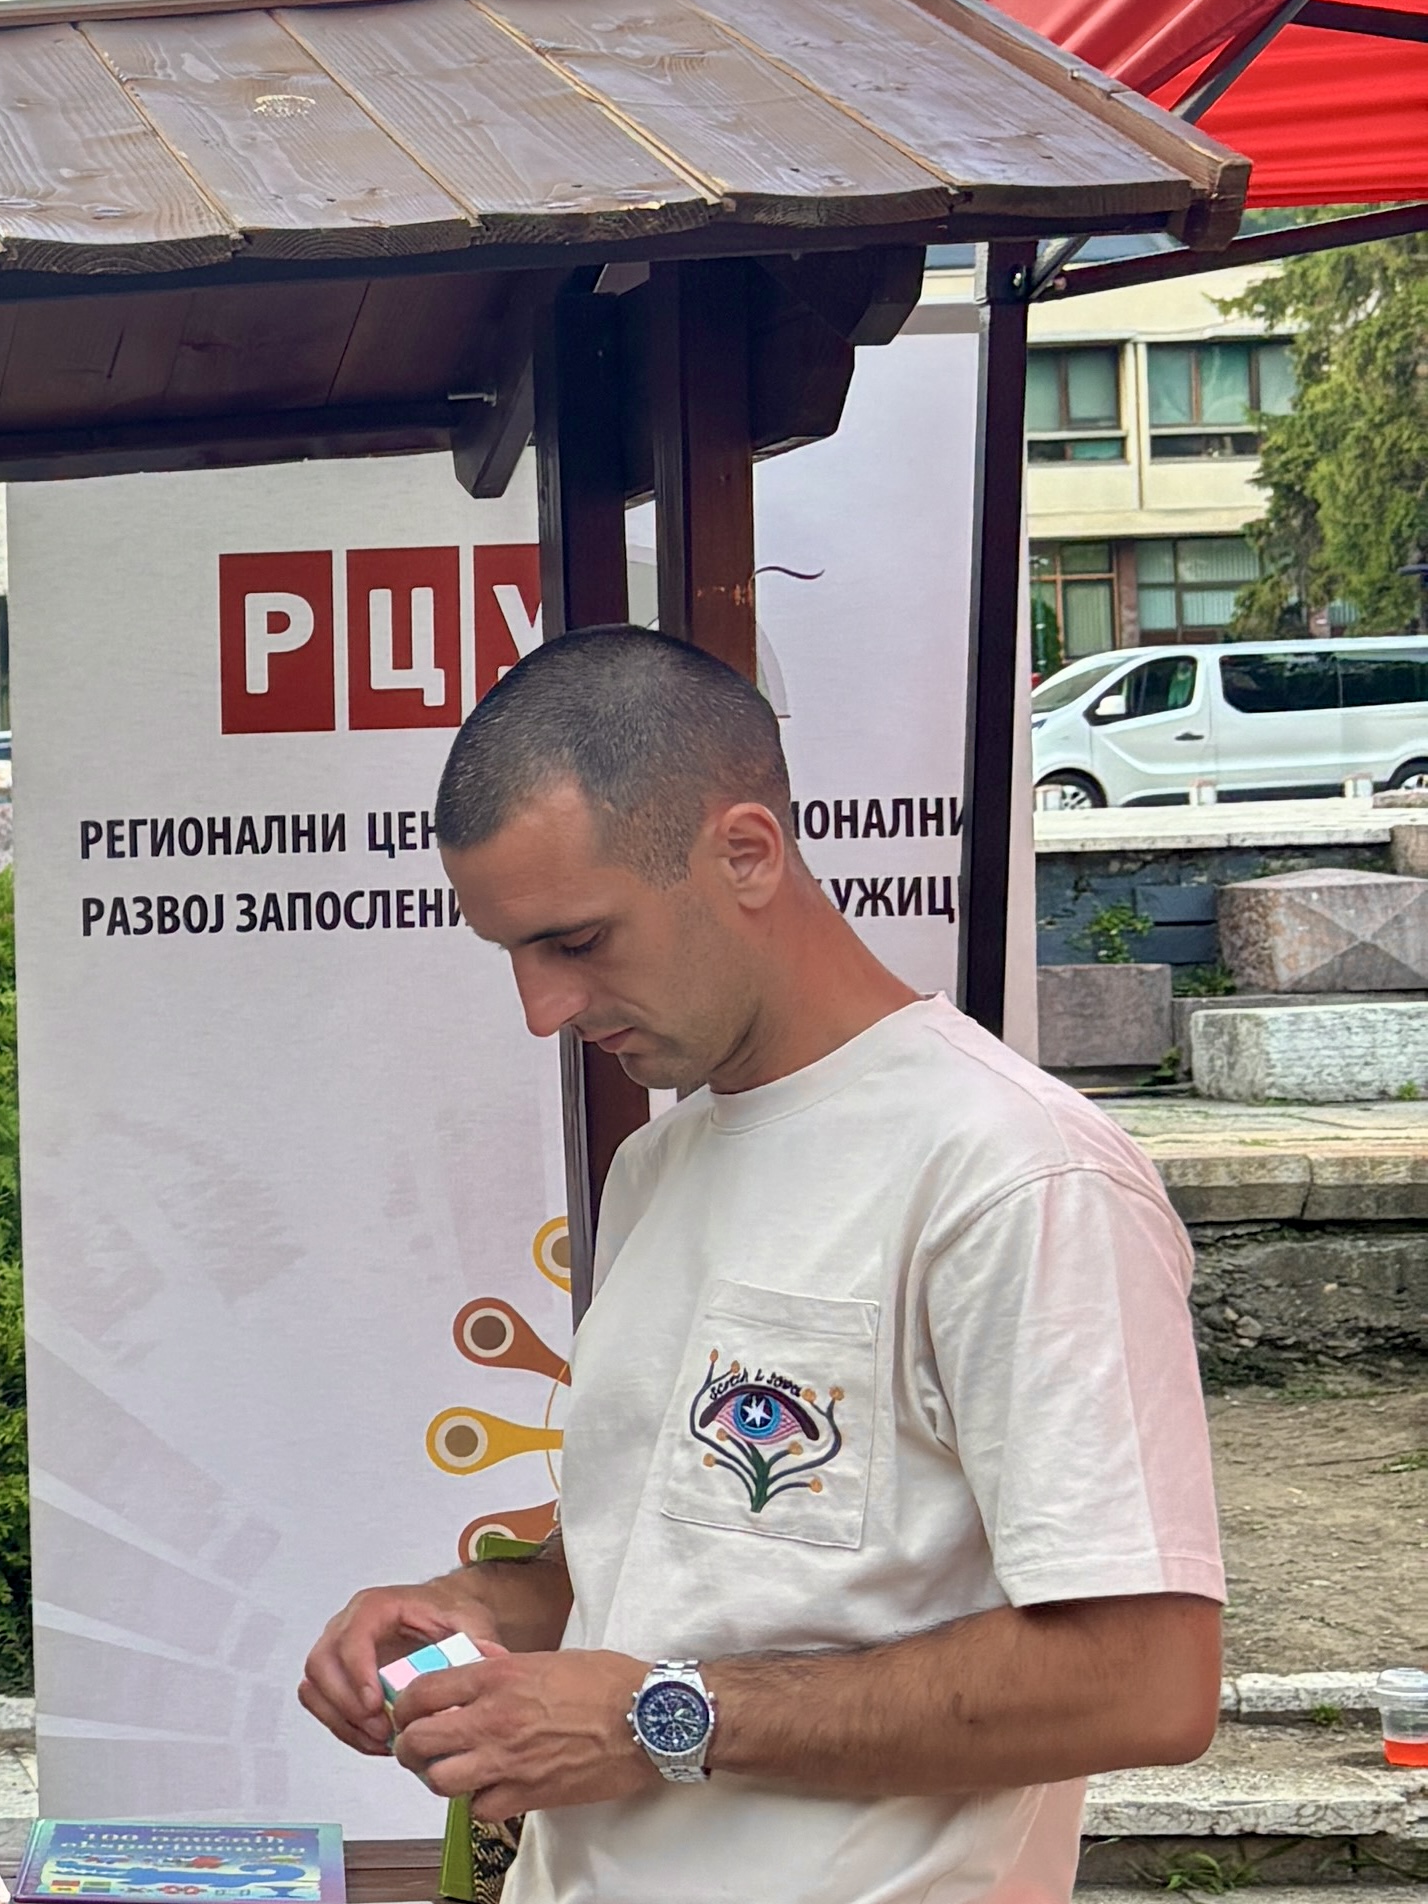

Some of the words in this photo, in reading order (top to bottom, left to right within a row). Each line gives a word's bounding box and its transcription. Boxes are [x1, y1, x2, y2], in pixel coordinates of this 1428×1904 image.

[80, 813, 346, 859] РЕГИОНАЛНИ
[82, 893, 224, 937] РАЗВОЈ
[87, 1832, 139, 1842] 100
